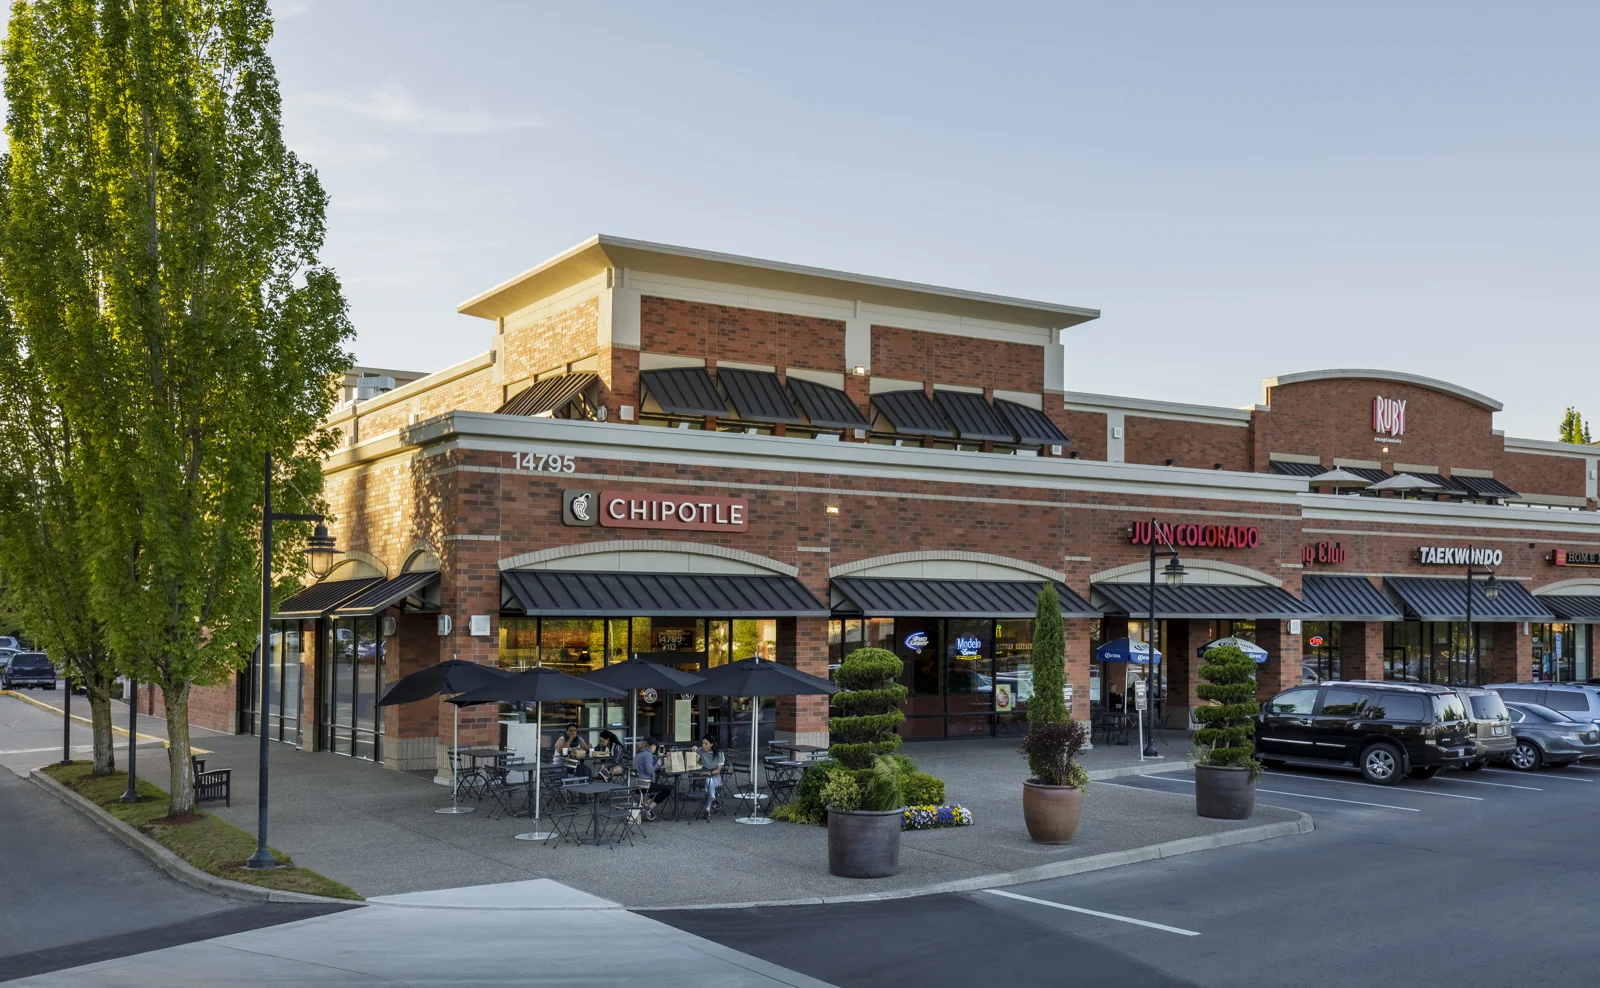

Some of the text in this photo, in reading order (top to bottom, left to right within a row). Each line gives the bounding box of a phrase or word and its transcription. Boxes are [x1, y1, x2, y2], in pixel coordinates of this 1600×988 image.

[1375, 395, 1406, 436] RUBY
[512, 451, 576, 473] 14795
[609, 498, 744, 524] CHIPOTLE
[1132, 521, 1259, 548] JUAN COLORADO
[1319, 541, 1347, 562] Club
[1420, 546, 1502, 565] TAEKWONDO
[1568, 552, 1595, 562] HOME
[957, 638, 981, 649] Modelo
